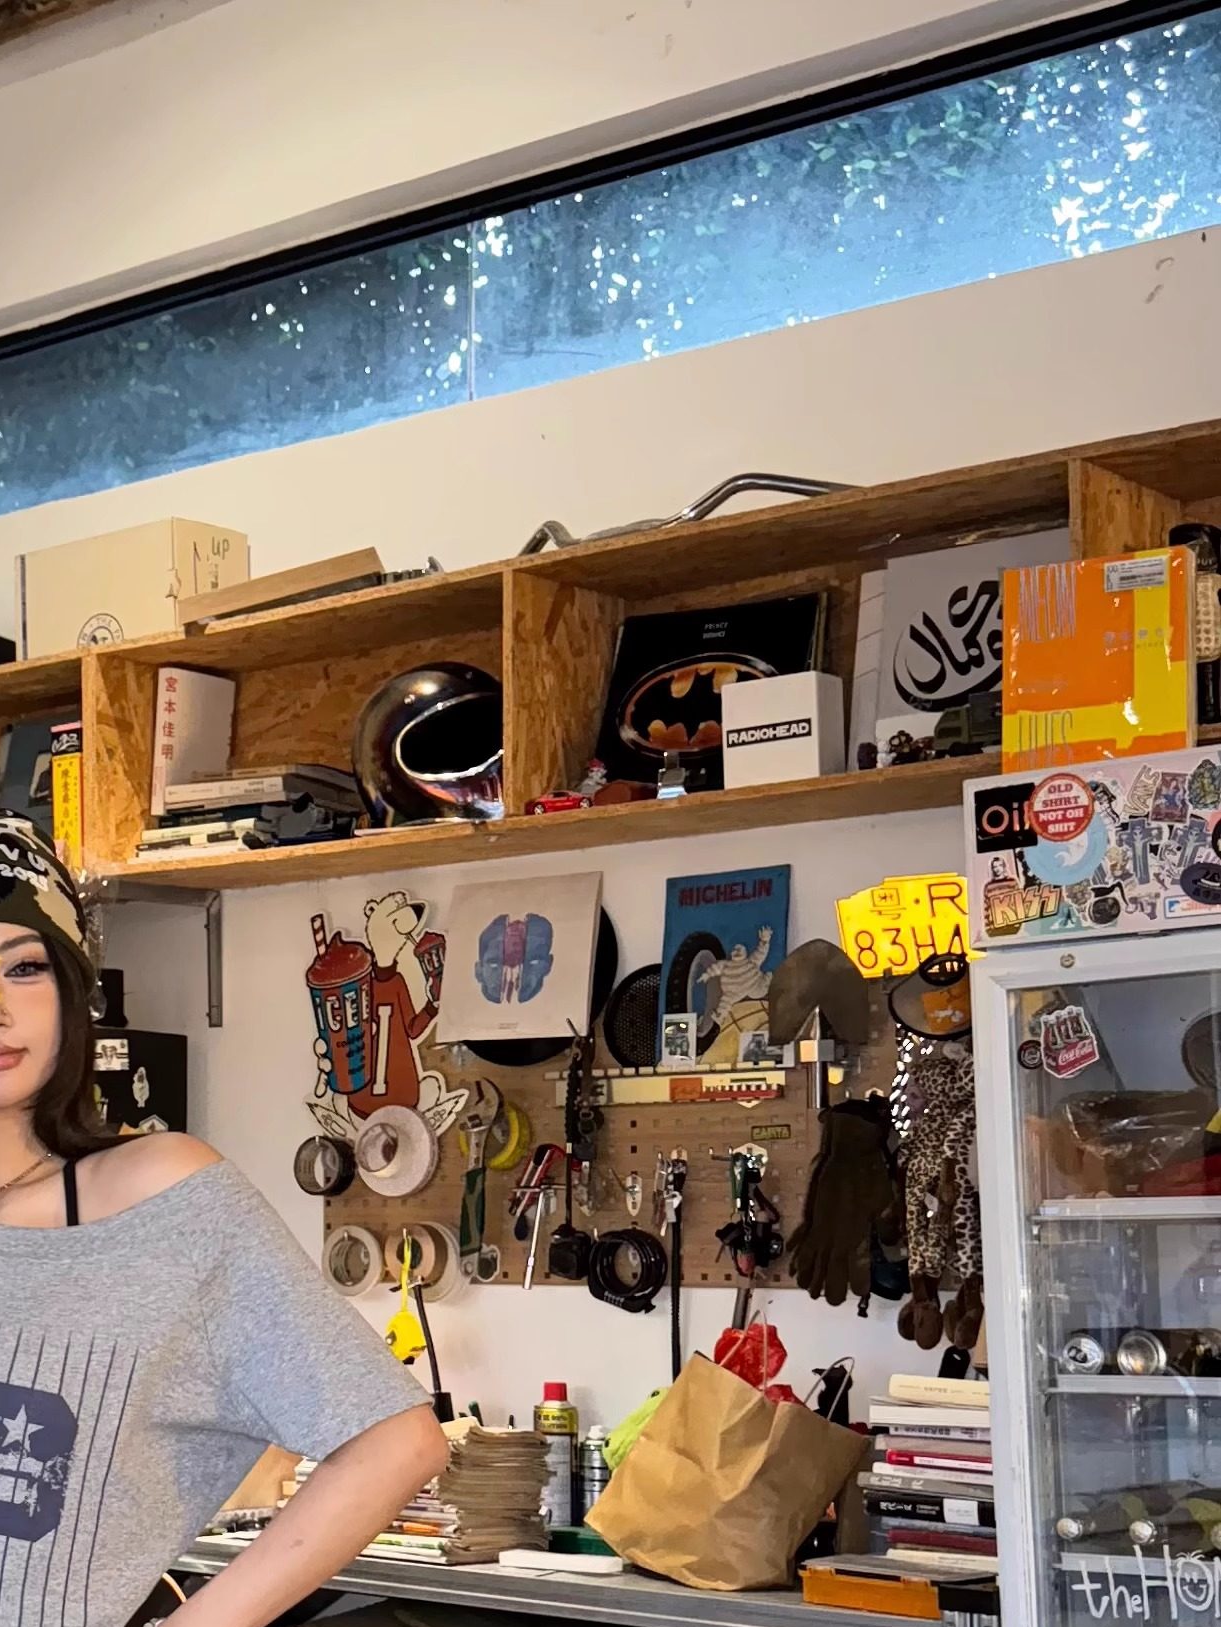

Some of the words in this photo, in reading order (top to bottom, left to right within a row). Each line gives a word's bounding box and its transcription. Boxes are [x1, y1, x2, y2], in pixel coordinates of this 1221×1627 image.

[727, 721, 811, 745] RADIOHEAD
[1047, 782, 1074, 795] OLD
[1041, 794, 1081, 809] SHIRT
[1038, 810, 1065, 822] NOT
[1066, 807, 1085, 819] OH
[1047, 821, 1077, 834] SHIT
[679, 878, 772, 907] MICHELIN
[990, 884, 1062, 928] KISS
